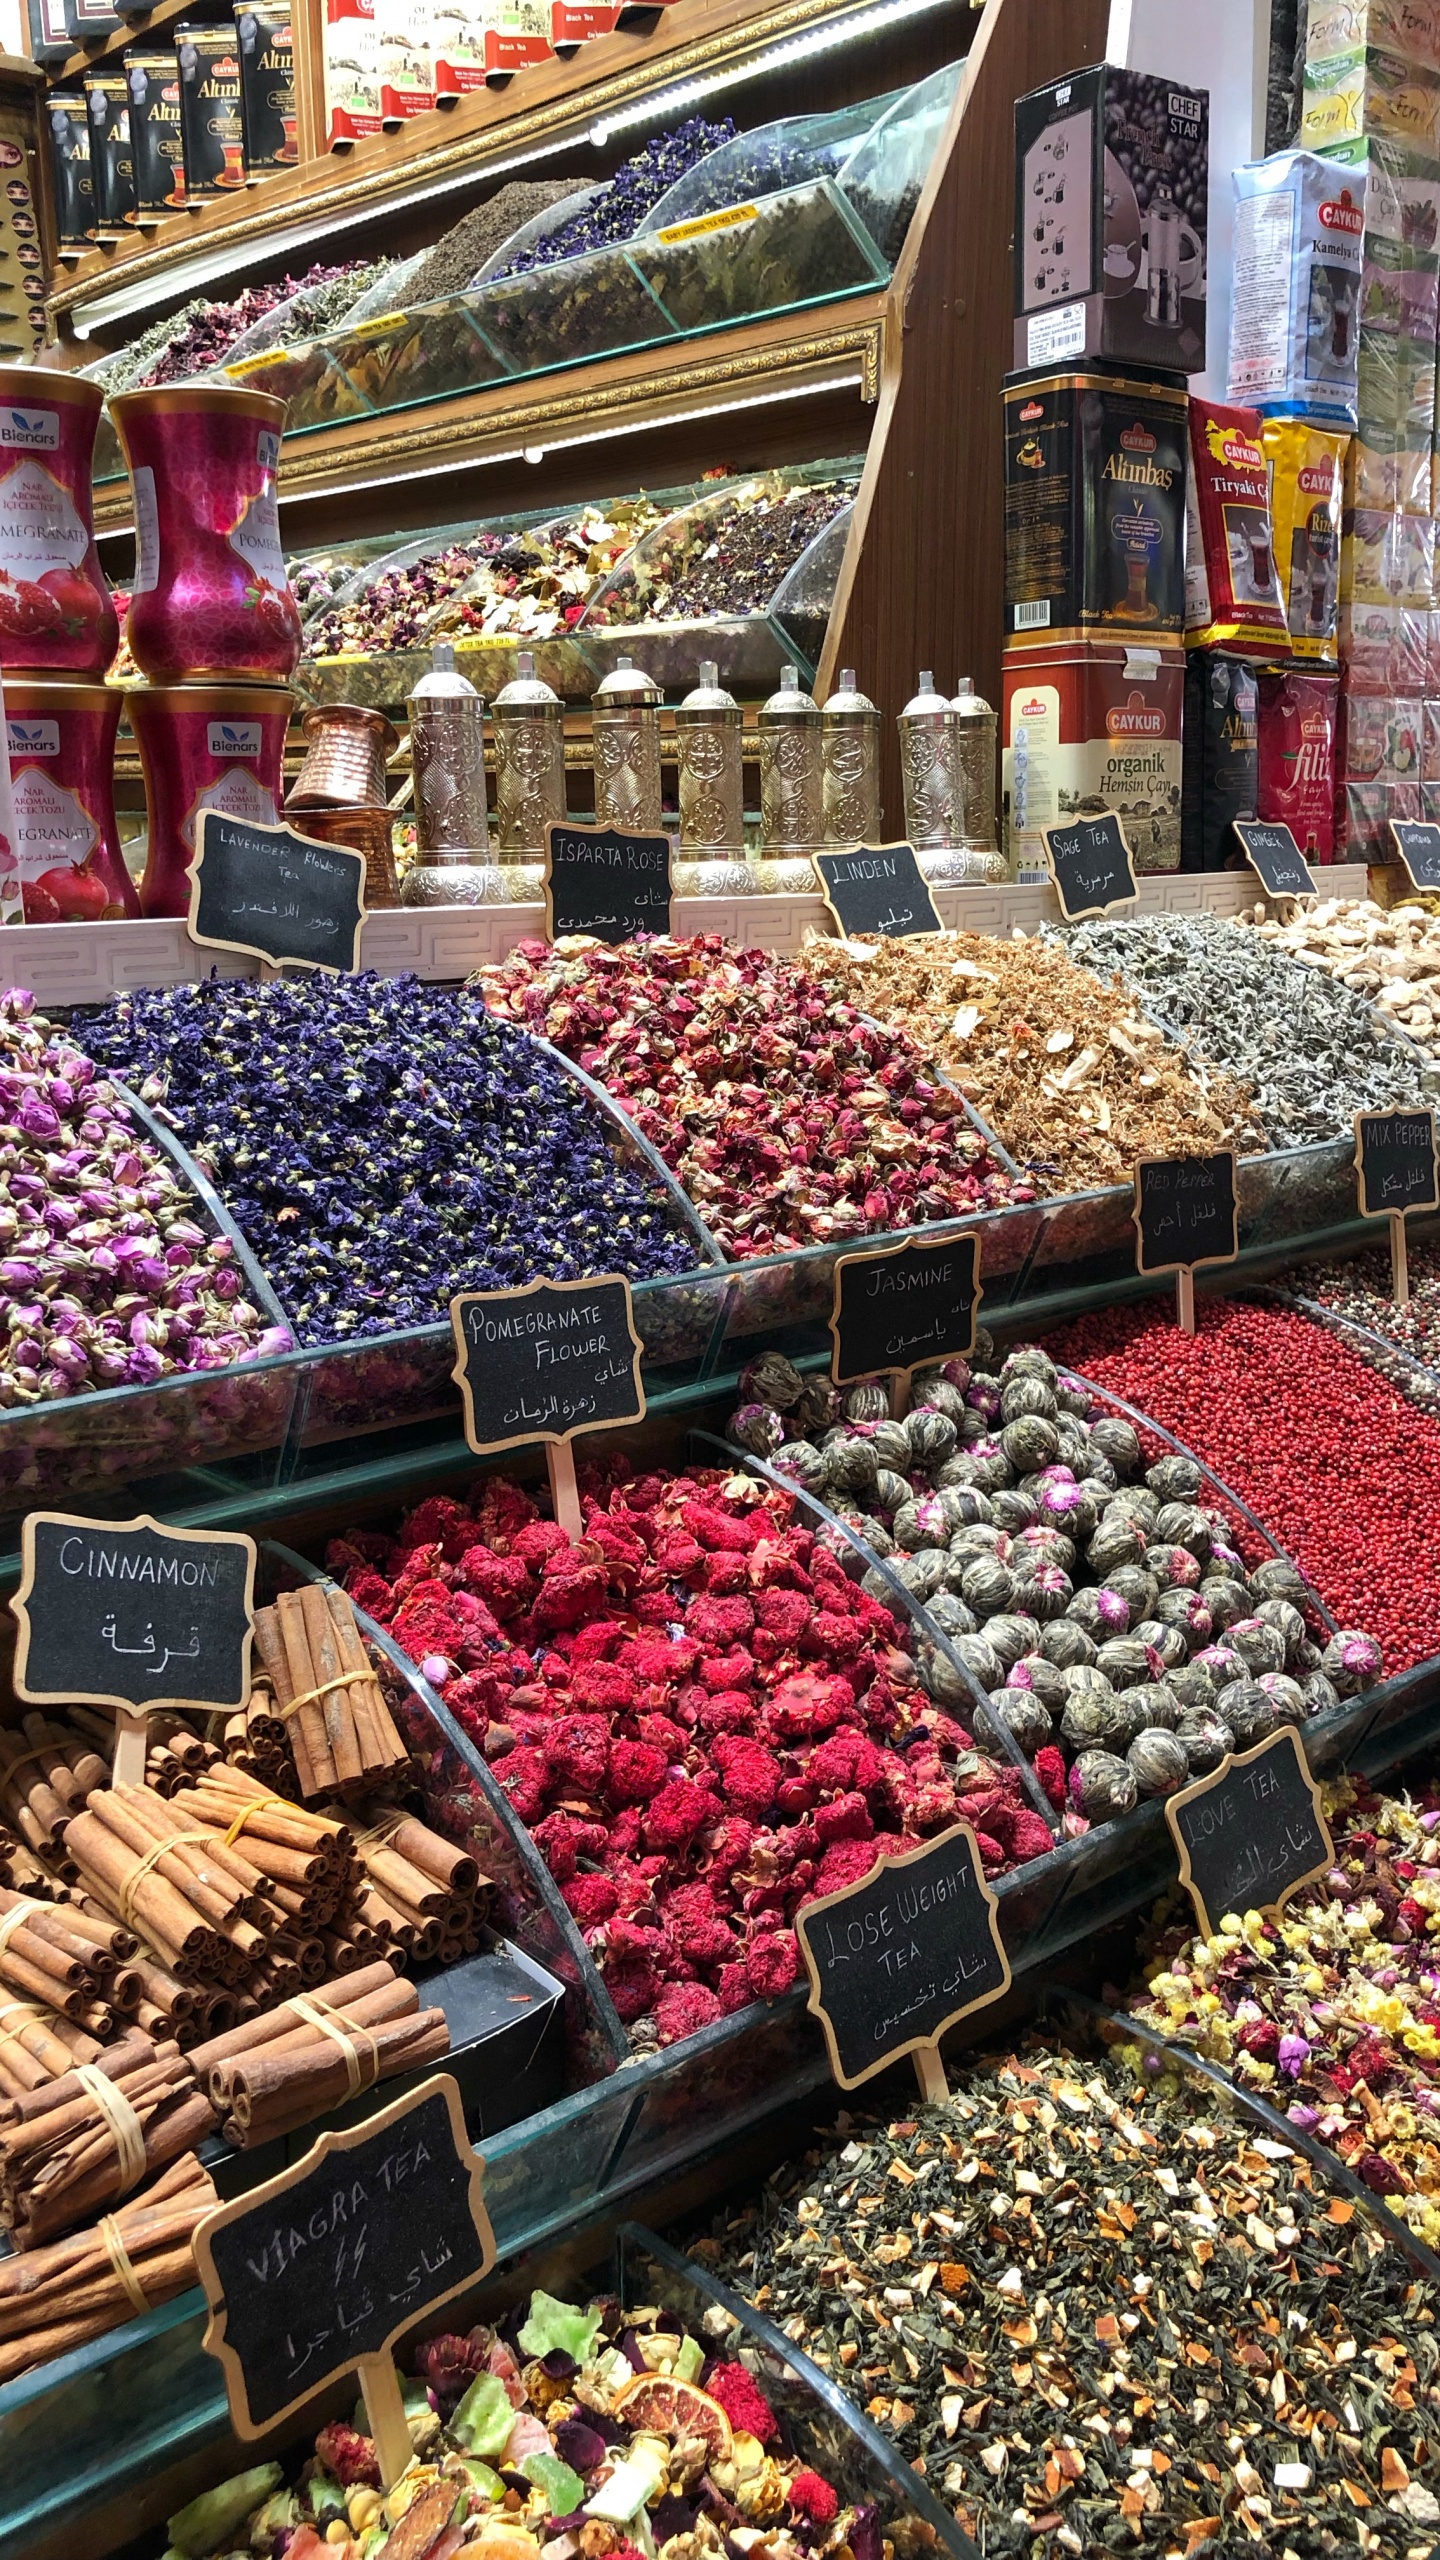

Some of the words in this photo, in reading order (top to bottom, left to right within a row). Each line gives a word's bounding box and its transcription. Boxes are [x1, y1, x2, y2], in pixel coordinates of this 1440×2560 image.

[1171, 96, 1199, 117] CHEF
[1170, 117, 1198, 139] STAR
[1313, 240, 1352, 259] Kamelya
[1, 428, 55, 445] Bienars
[1101, 453, 1173, 491] Altınbaş
[22, 483, 43, 491] NAR
[1210, 477, 1256, 497] Tiryaki
[1312, 513, 1333, 533] Rize
[212, 741, 258, 751] Bienars
[1107, 752, 1166, 777] organik
[24, 788, 45, 796] NAR
[229, 786, 247, 794] NAR
[1099, 775, 1144, 795] Hemşin
[1146, 775, 1171, 798] Çayı
[13, 797, 55, 805] AROMALI
[39, 806, 66, 814] TOZU
[220, 828, 291, 858] LAVENDER
[1052, 834, 1081, 859] SAGE
[1085, 827, 1110, 847] TEA
[1247, 830, 1284, 849] GINGER
[556, 837, 623, 866] ISPARTA
[626, 845, 664, 871] ROSE
[278, 866, 300, 881] Tea
[832, 858, 897, 884] LINDEN
[1366, 1122, 1392, 1148] MIX
[1395, 1121, 1432, 1147] PEPPER
[1145, 1170, 1170, 1192] RED
[1175, 1168, 1215, 1190] PEPPER
[866, 1263, 953, 1297] JASMINE
[468, 1305, 602, 1344] POMEGRANATE
[534, 1335, 611, 1371] FLOWER
[60, 1536, 219, 1587] CINNAMON
[101, 1613, 200, 1673] قرفة
[1185, 1795, 1237, 1848] LOVE
[1243, 1767, 1281, 1801] TEA
[826, 1905, 895, 1968] LOSE
[896, 1865, 969, 1924] WEIGHT
[877, 1941, 922, 1976] TEA
[246, 2181, 369, 2283] VIAGRA
[375, 2141, 432, 2191] TEA
